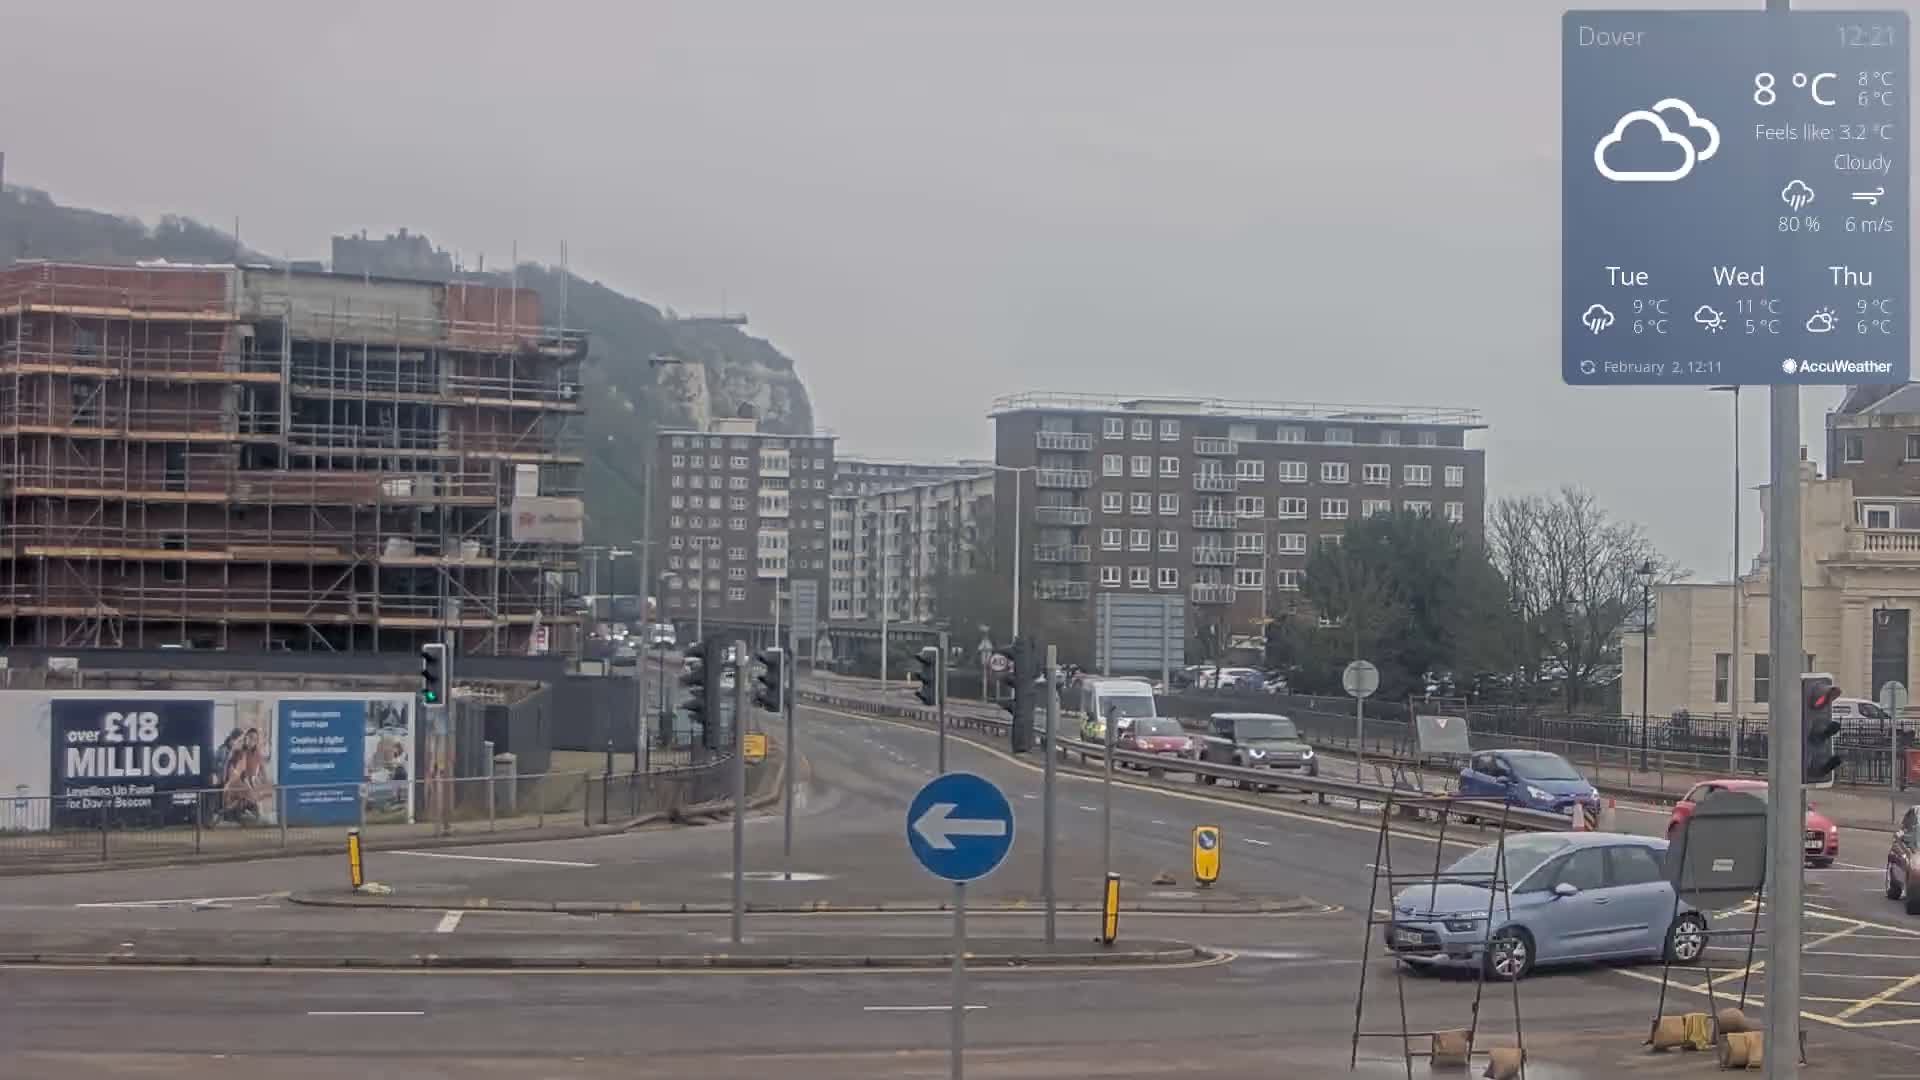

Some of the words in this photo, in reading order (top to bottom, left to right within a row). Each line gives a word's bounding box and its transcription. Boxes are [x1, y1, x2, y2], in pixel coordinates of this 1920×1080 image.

[67, 730, 101, 743] over
[104, 711, 160, 742] £18
[66, 744, 201, 778] MILLION
[82, 797, 112, 809] Dovr
